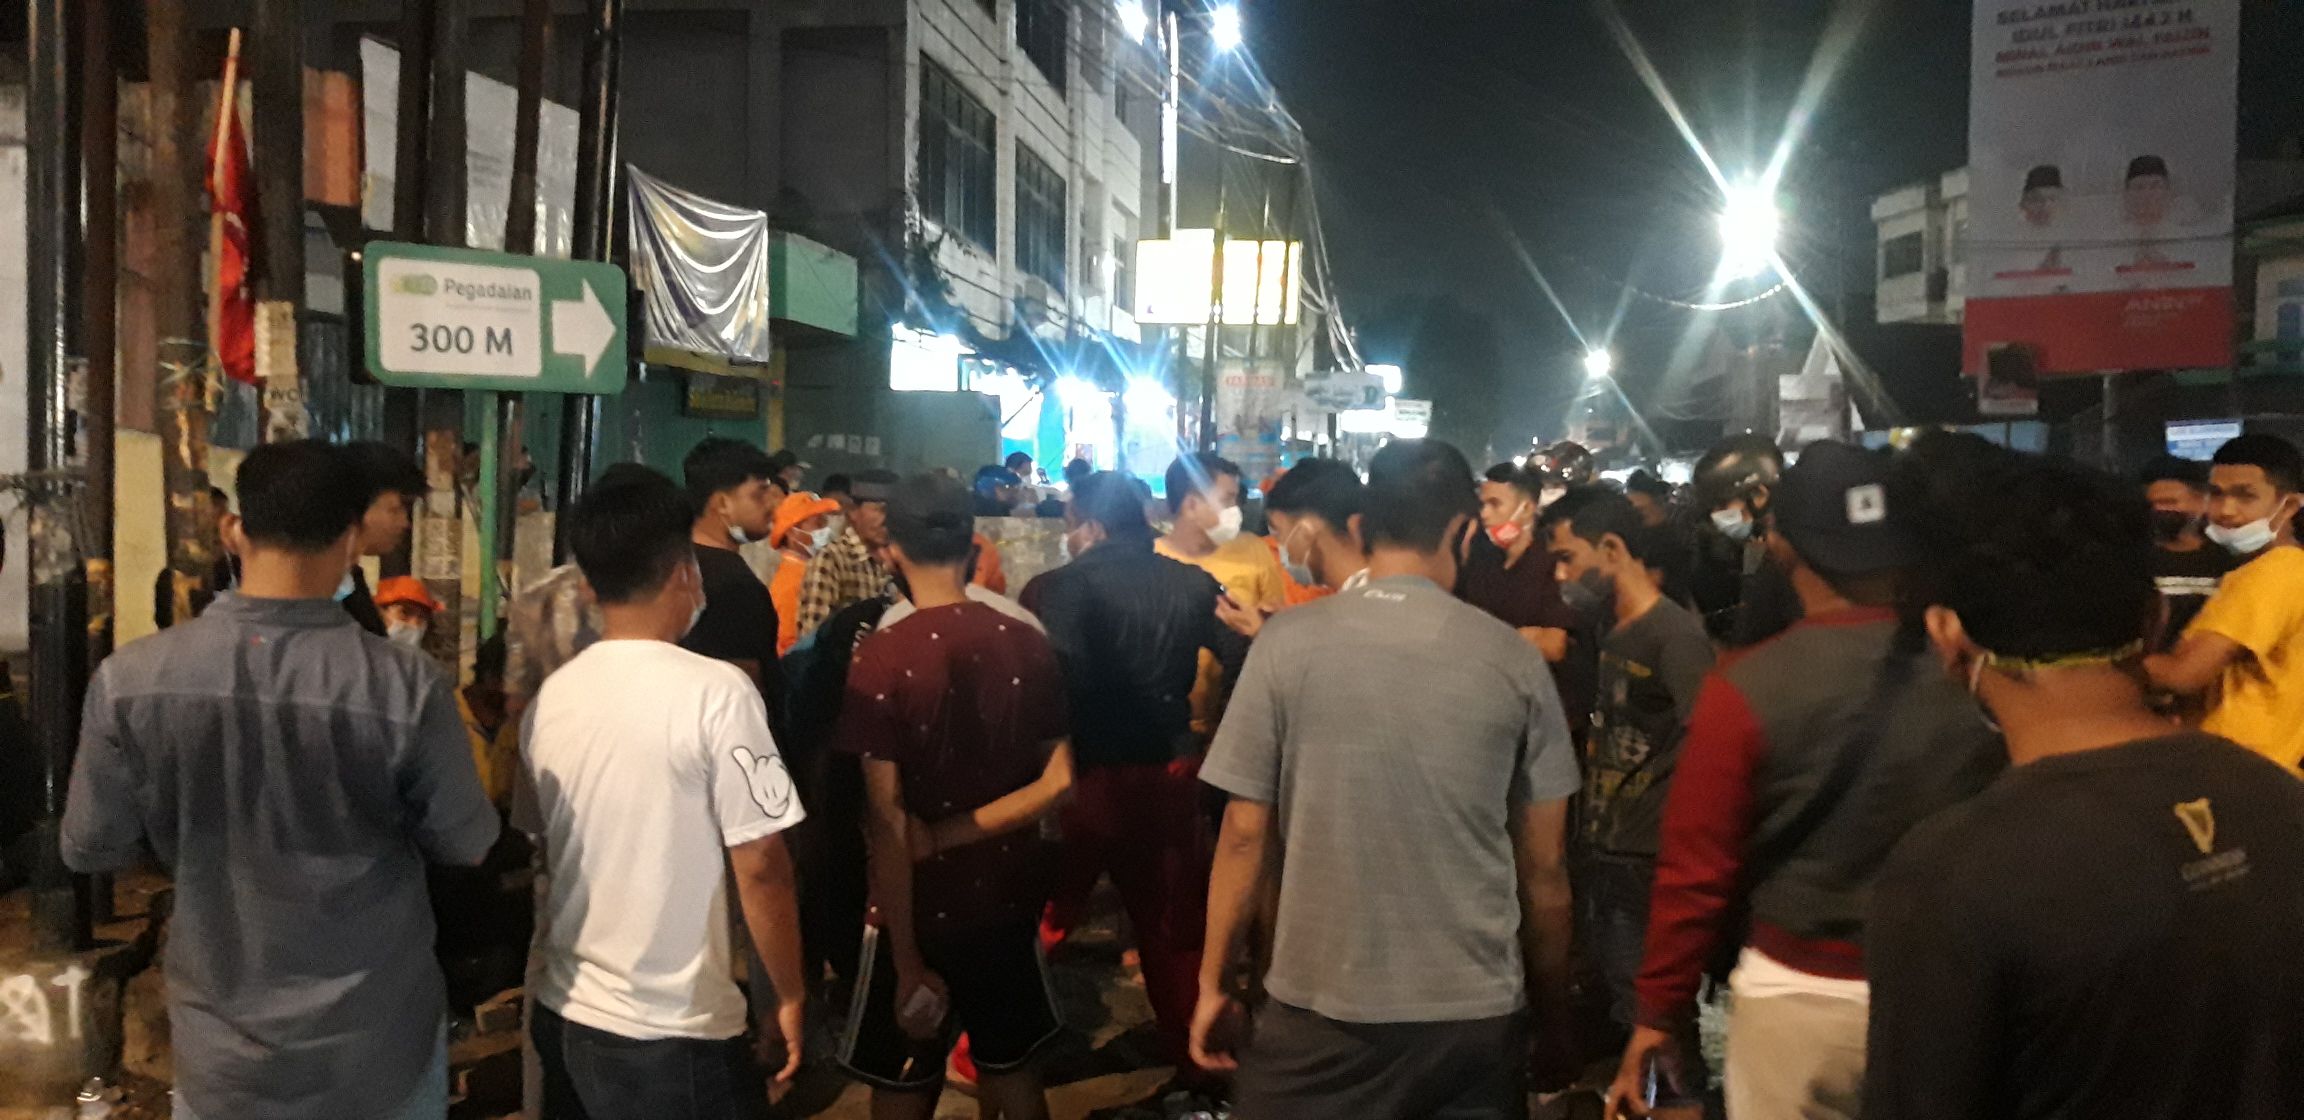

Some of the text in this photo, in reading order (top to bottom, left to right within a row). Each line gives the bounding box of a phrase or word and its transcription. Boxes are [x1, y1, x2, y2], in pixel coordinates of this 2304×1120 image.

[443, 277, 532, 301] Pegadaian
[409, 322, 513, 356] 300 M
